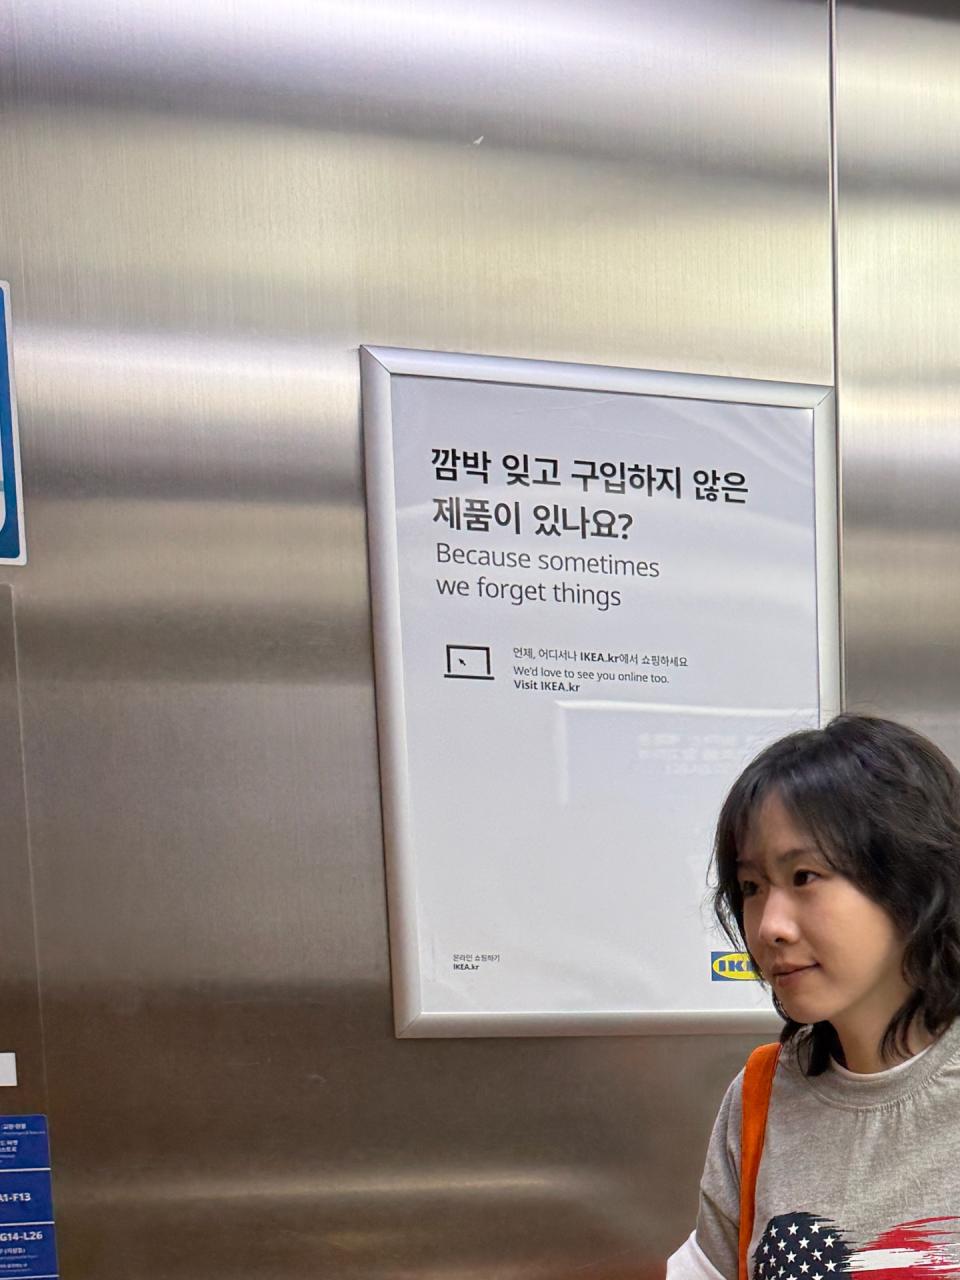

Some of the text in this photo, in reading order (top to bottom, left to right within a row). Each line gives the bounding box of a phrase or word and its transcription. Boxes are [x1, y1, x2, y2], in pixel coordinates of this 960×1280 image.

[431, 448, 748, 504] 깜박 잊고 구입하지 않은
[432, 496, 633, 540] 제품이 있나요?
[436, 542, 660, 577] Because sometimes
[436, 576, 621, 611] we forget things
[513, 647, 688, 667] 언제, 어디서나 IKEA.kr에서 쇼핑하세요
[513, 666, 670, 684] We'd love to see you online too.
[514, 680, 580, 692] Visit IKEA.kr
